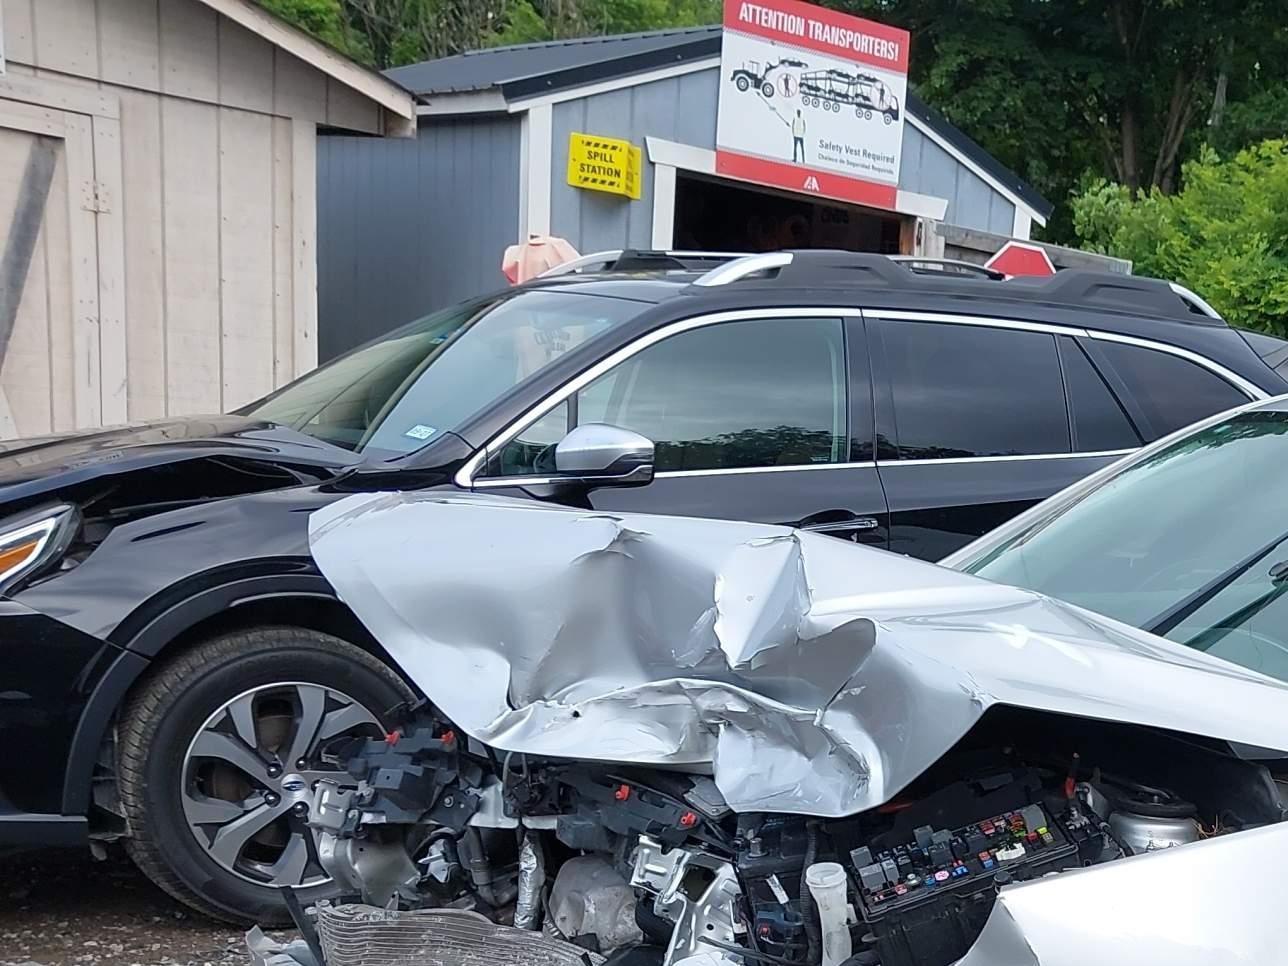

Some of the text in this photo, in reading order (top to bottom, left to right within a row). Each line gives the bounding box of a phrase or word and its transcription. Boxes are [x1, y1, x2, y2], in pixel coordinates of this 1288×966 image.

[739, 2, 899, 62] ATTENTION TRANSPORTERS!
[579, 150, 621, 179] SPILL STATION
[818, 139, 895, 165] Safety Vest Required
